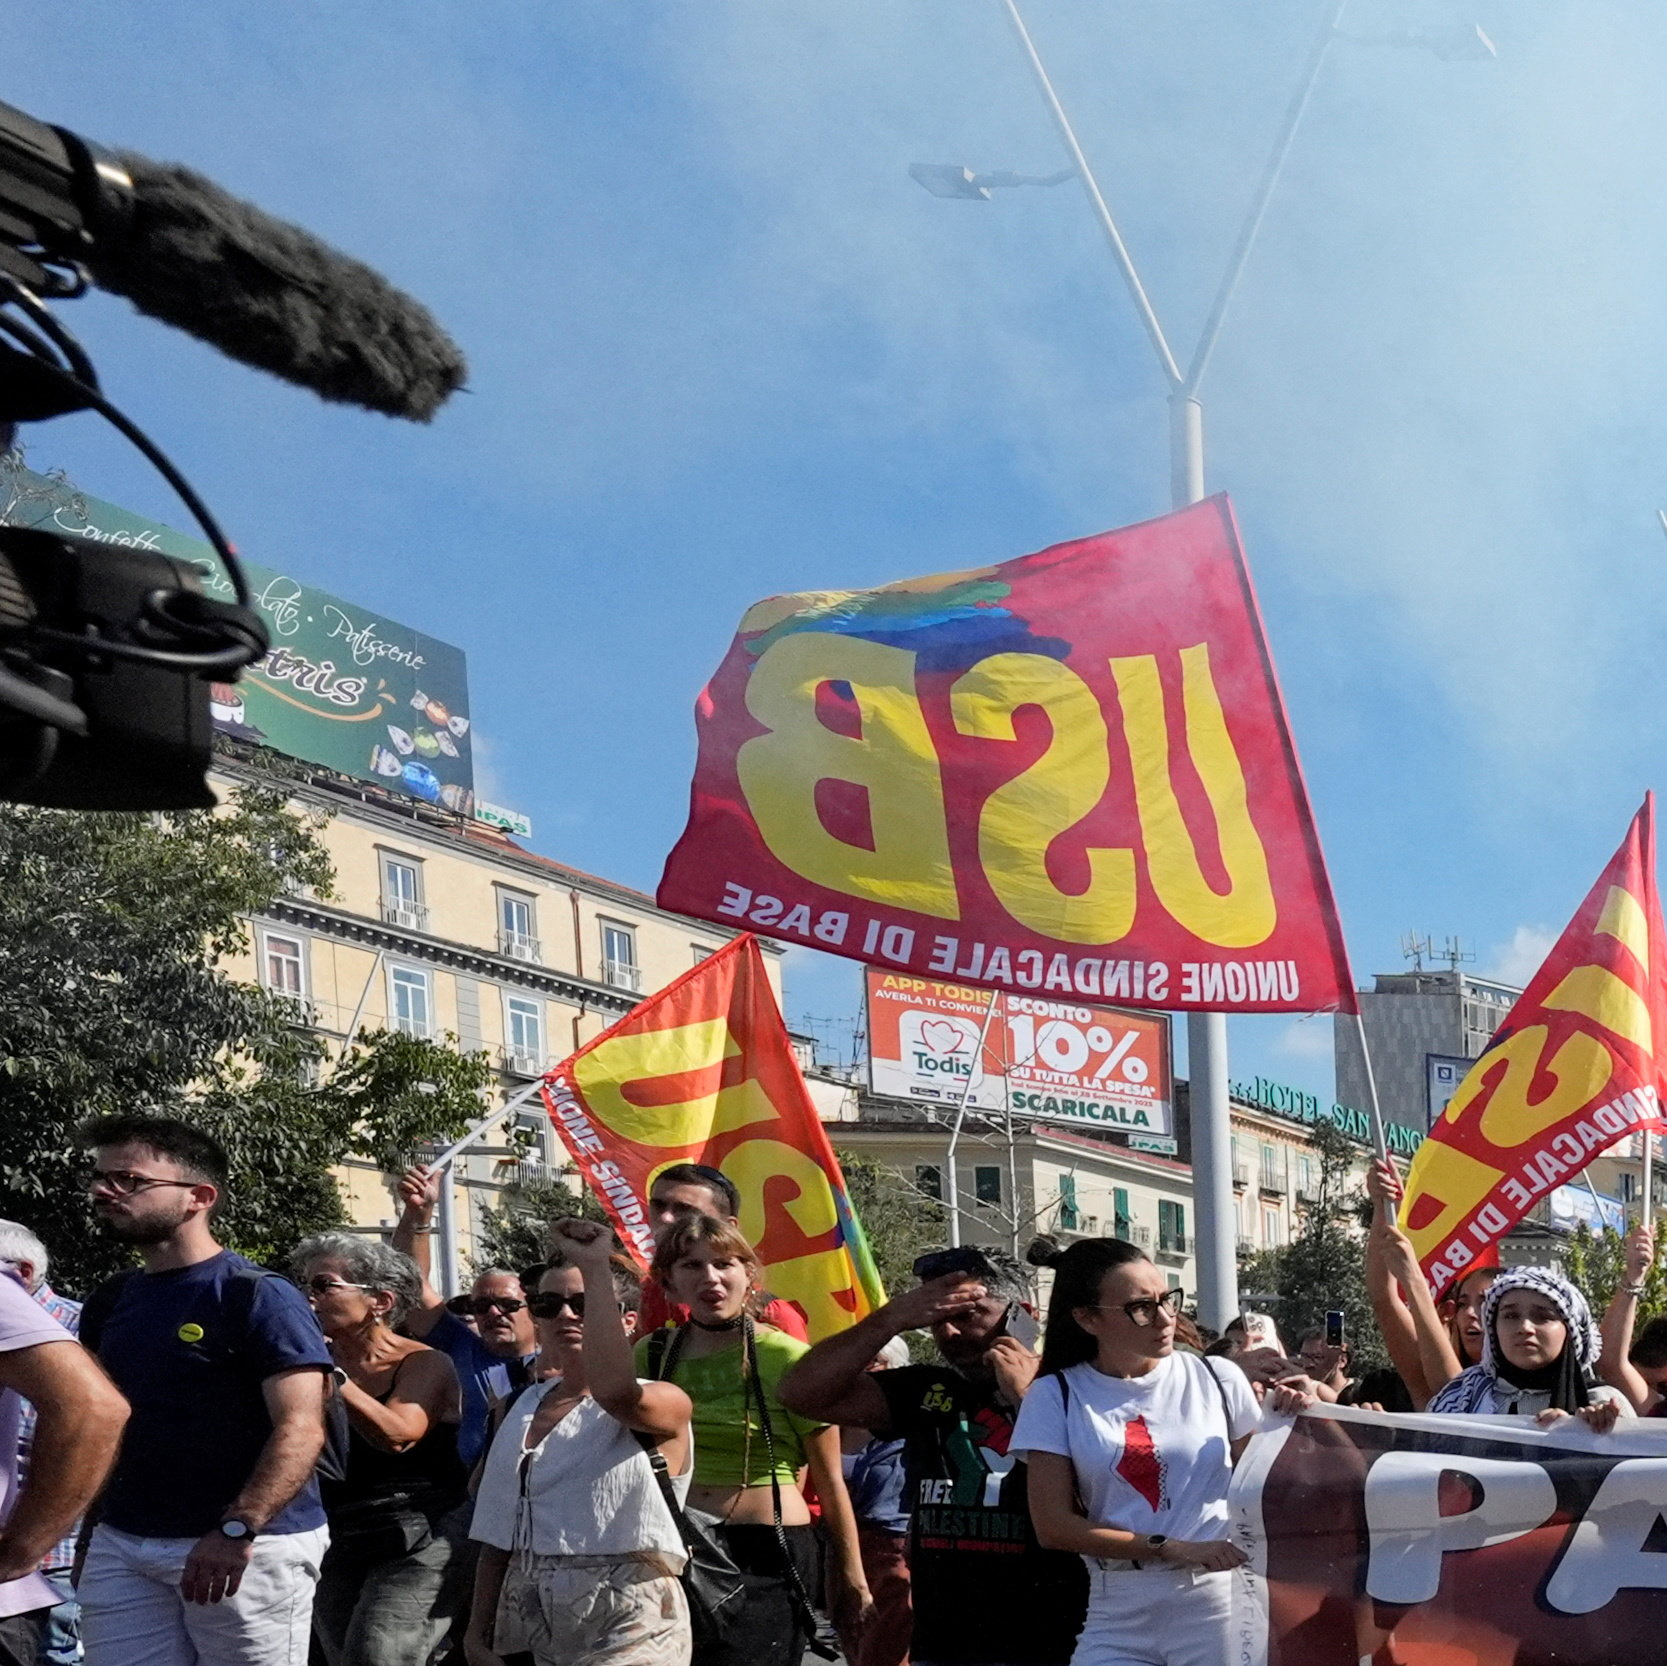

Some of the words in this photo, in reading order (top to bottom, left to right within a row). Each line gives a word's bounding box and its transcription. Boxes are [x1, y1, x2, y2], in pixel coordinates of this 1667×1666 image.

[54, 507, 162, 551] Confett
[324, 604, 427, 669] Patisserie
[875, 990, 922, 1005] AVERLA
[925, 998, 936, 1007] TI
[882, 975, 926, 993] APP
[931, 983, 993, 1004] TODIS
[1007, 996, 1092, 1024] SCONTO
[912, 1050, 971, 1076] Todis
[1007, 1014, 1149, 1083] 10%
[1010, 1065, 1031, 1079] SU
[1033, 1069, 1080, 1087] TUTTA
[1083, 1077, 1103, 1090] LA
[1011, 1090, 1150, 1127] SCARICALA
[590, 1159, 657, 1266] SINDAC
